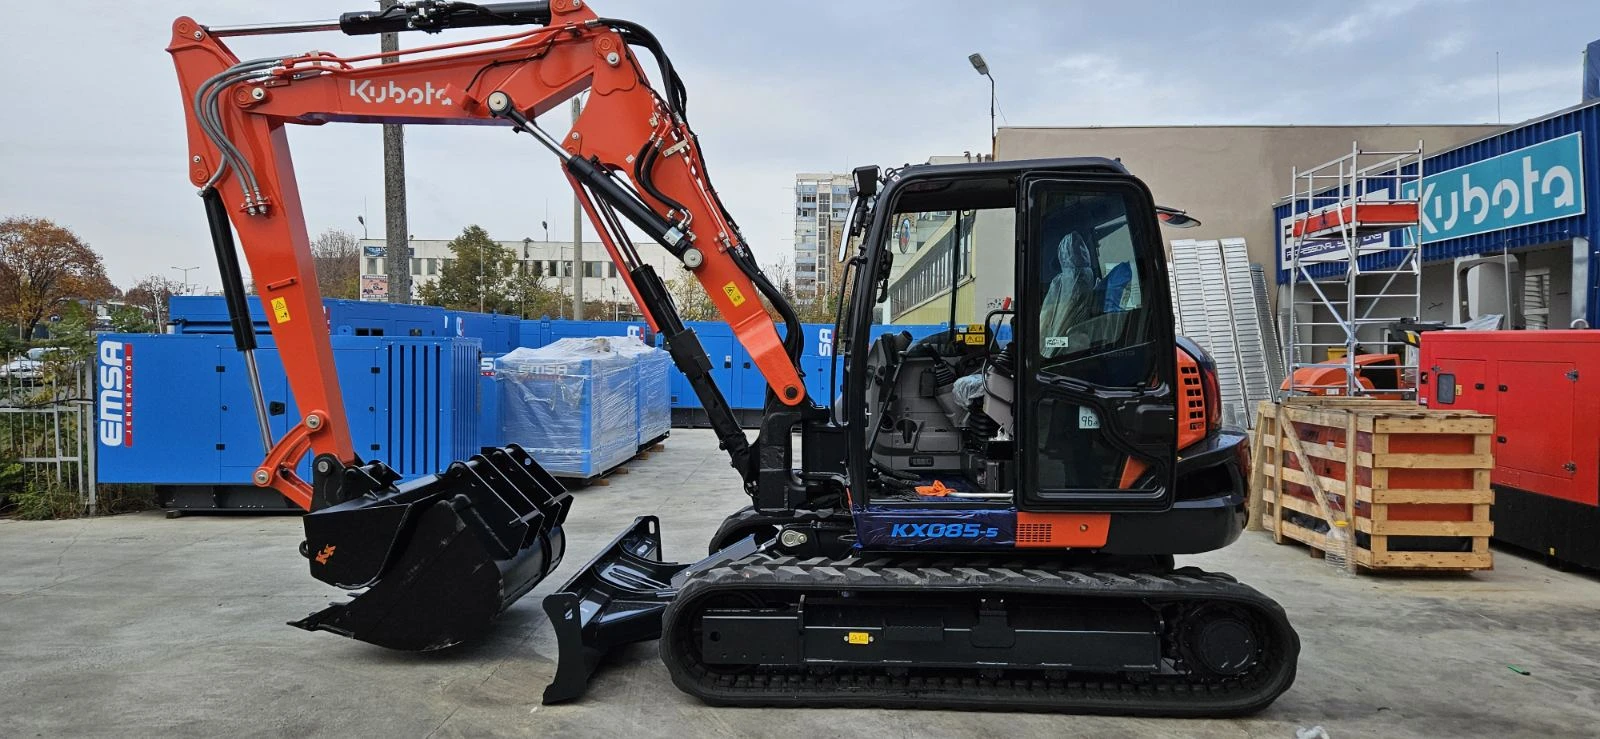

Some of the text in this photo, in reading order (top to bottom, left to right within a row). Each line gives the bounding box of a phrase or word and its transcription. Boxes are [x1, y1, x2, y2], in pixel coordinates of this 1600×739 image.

[1408, 155, 1574, 235] Kubota
[100, 340, 123, 447] EMSA
[891, 523, 999, 538] KX085-5
